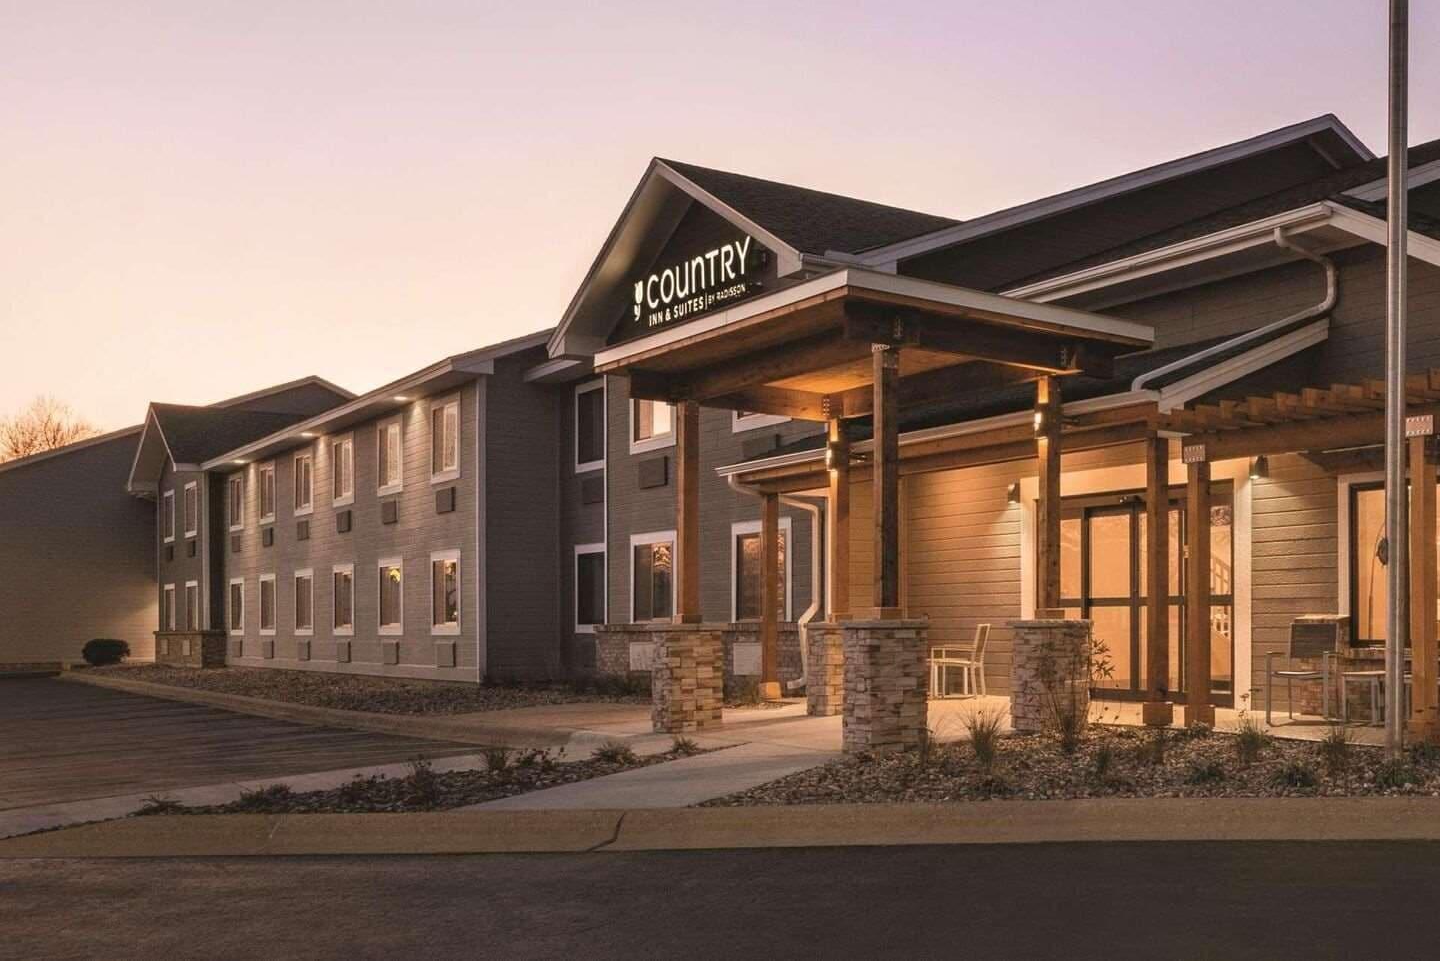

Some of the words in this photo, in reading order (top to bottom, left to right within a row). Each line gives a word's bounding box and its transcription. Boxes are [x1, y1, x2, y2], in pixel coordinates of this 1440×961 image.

[649, 310, 663, 327] INN
[665, 308, 672, 321] &
[673, 296, 704, 319] SUITES
[708, 293, 715, 305] BY
[716, 283, 746, 300] RADISSON
